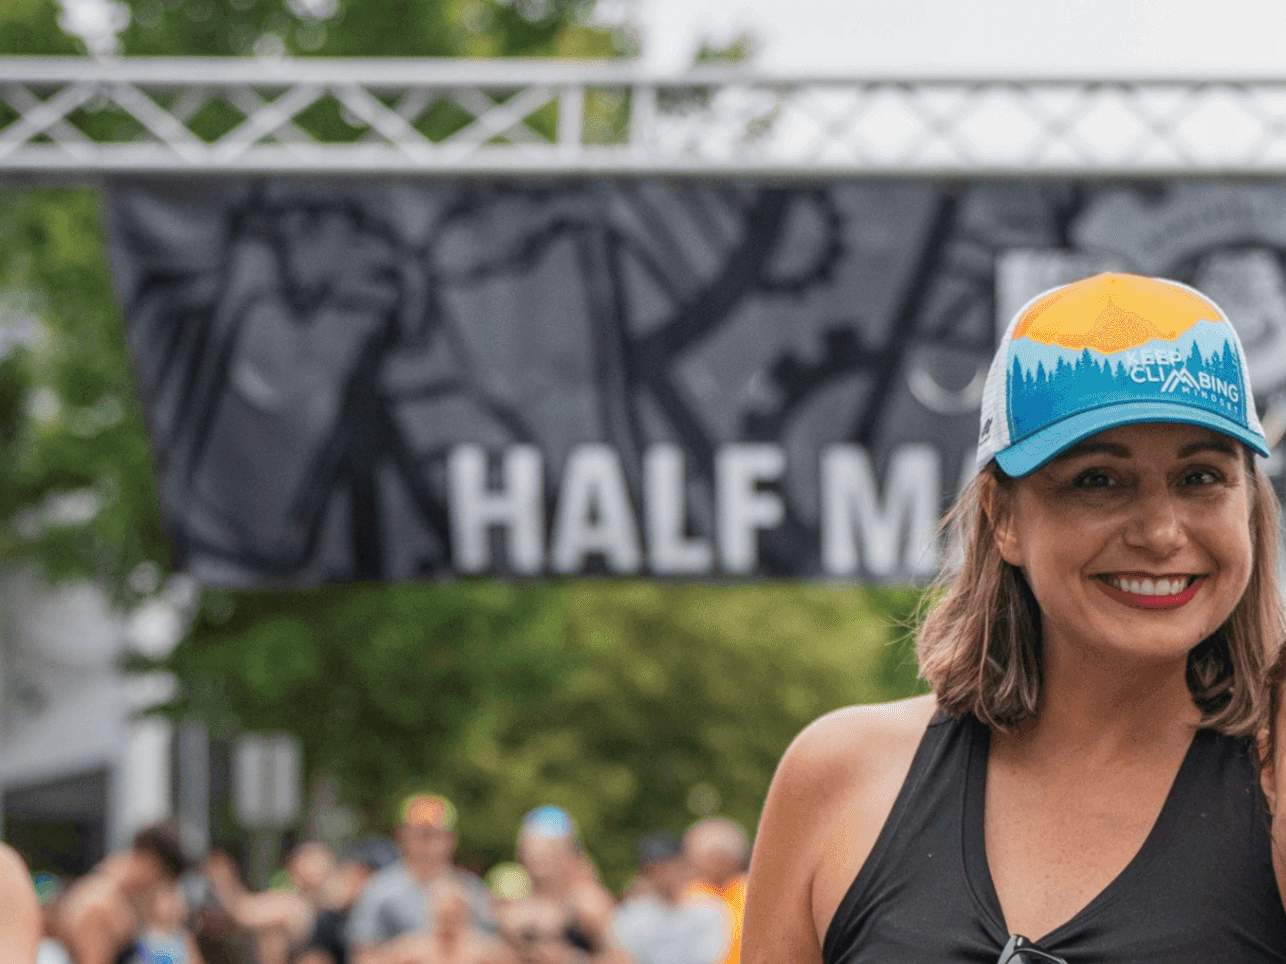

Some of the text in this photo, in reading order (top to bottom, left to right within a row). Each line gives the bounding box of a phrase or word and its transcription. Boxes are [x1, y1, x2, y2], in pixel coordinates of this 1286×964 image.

[1125, 348, 1183, 367] KEEP
[1130, 366, 1240, 403] CLIMBING
[449, 443, 788, 572] HALF
